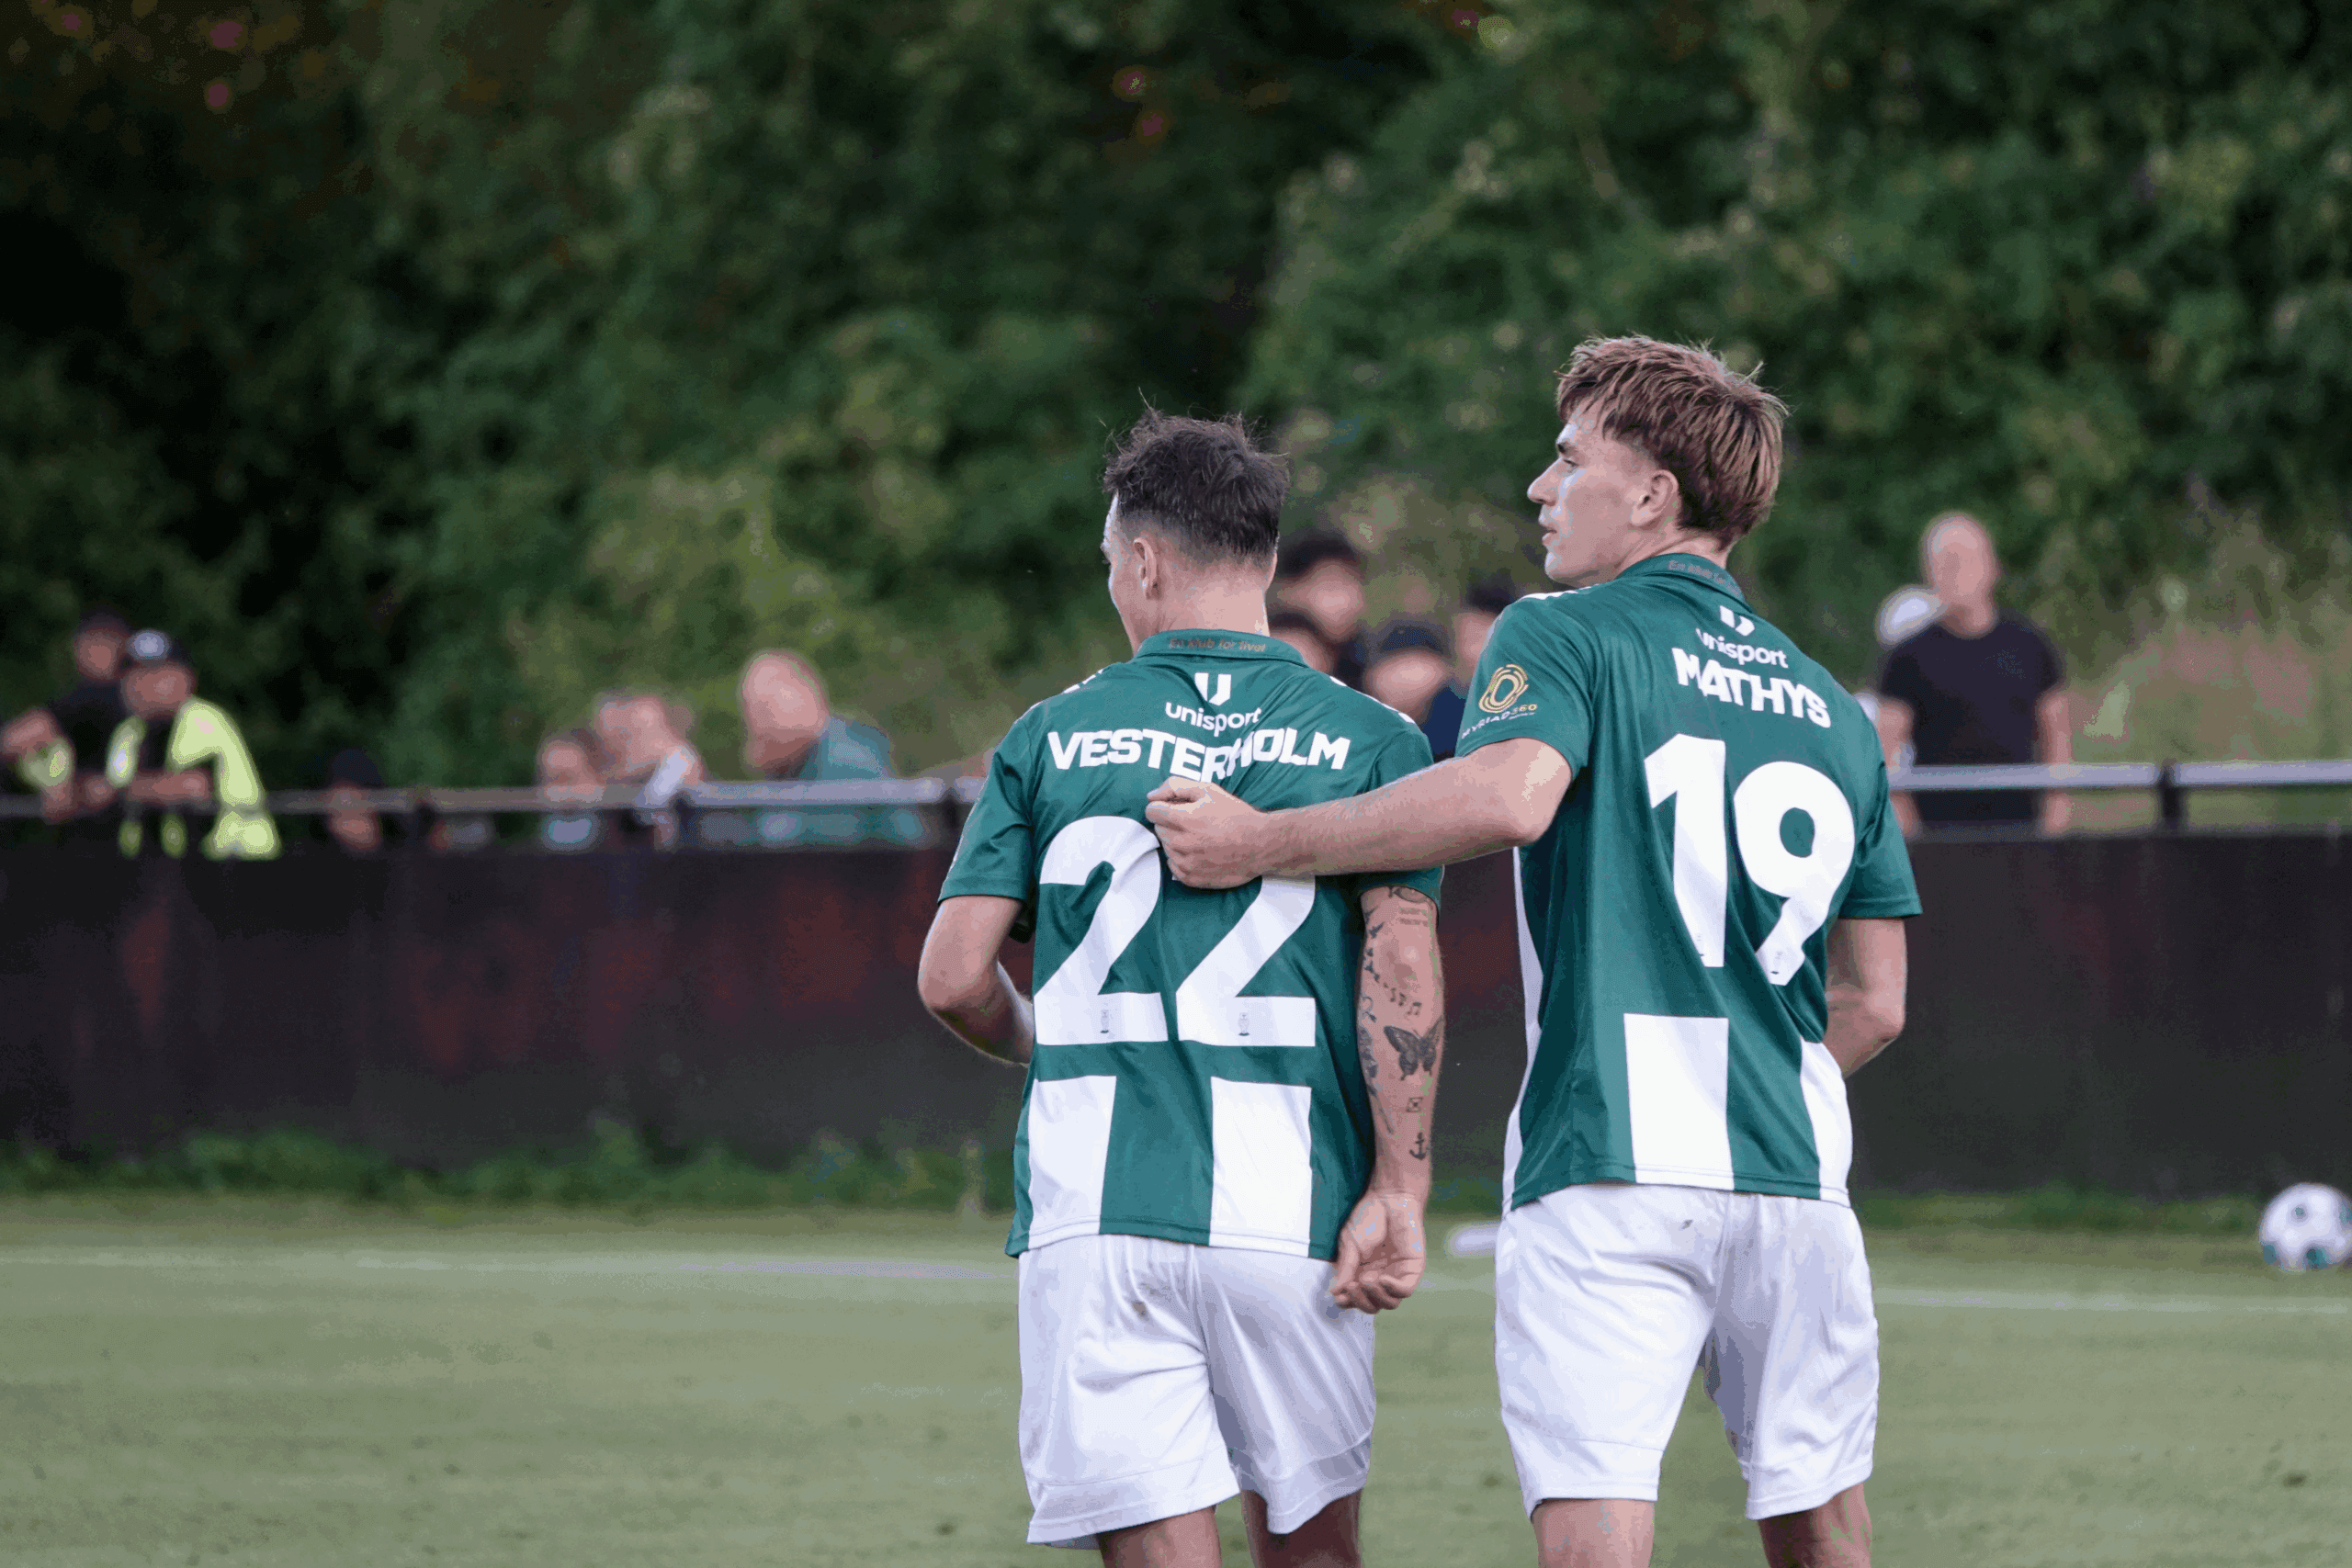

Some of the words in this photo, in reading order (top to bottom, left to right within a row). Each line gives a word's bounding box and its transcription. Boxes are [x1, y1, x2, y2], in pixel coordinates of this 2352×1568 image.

[1218, 637, 1236, 649] for
[1165, 702, 1261, 737] unisport
[1672, 647, 1831, 728] MATHYS
[1047, 728, 1350, 784] VESTERHOLM
[1645, 734, 1855, 986] 19
[1034, 815, 1317, 1047] 22
